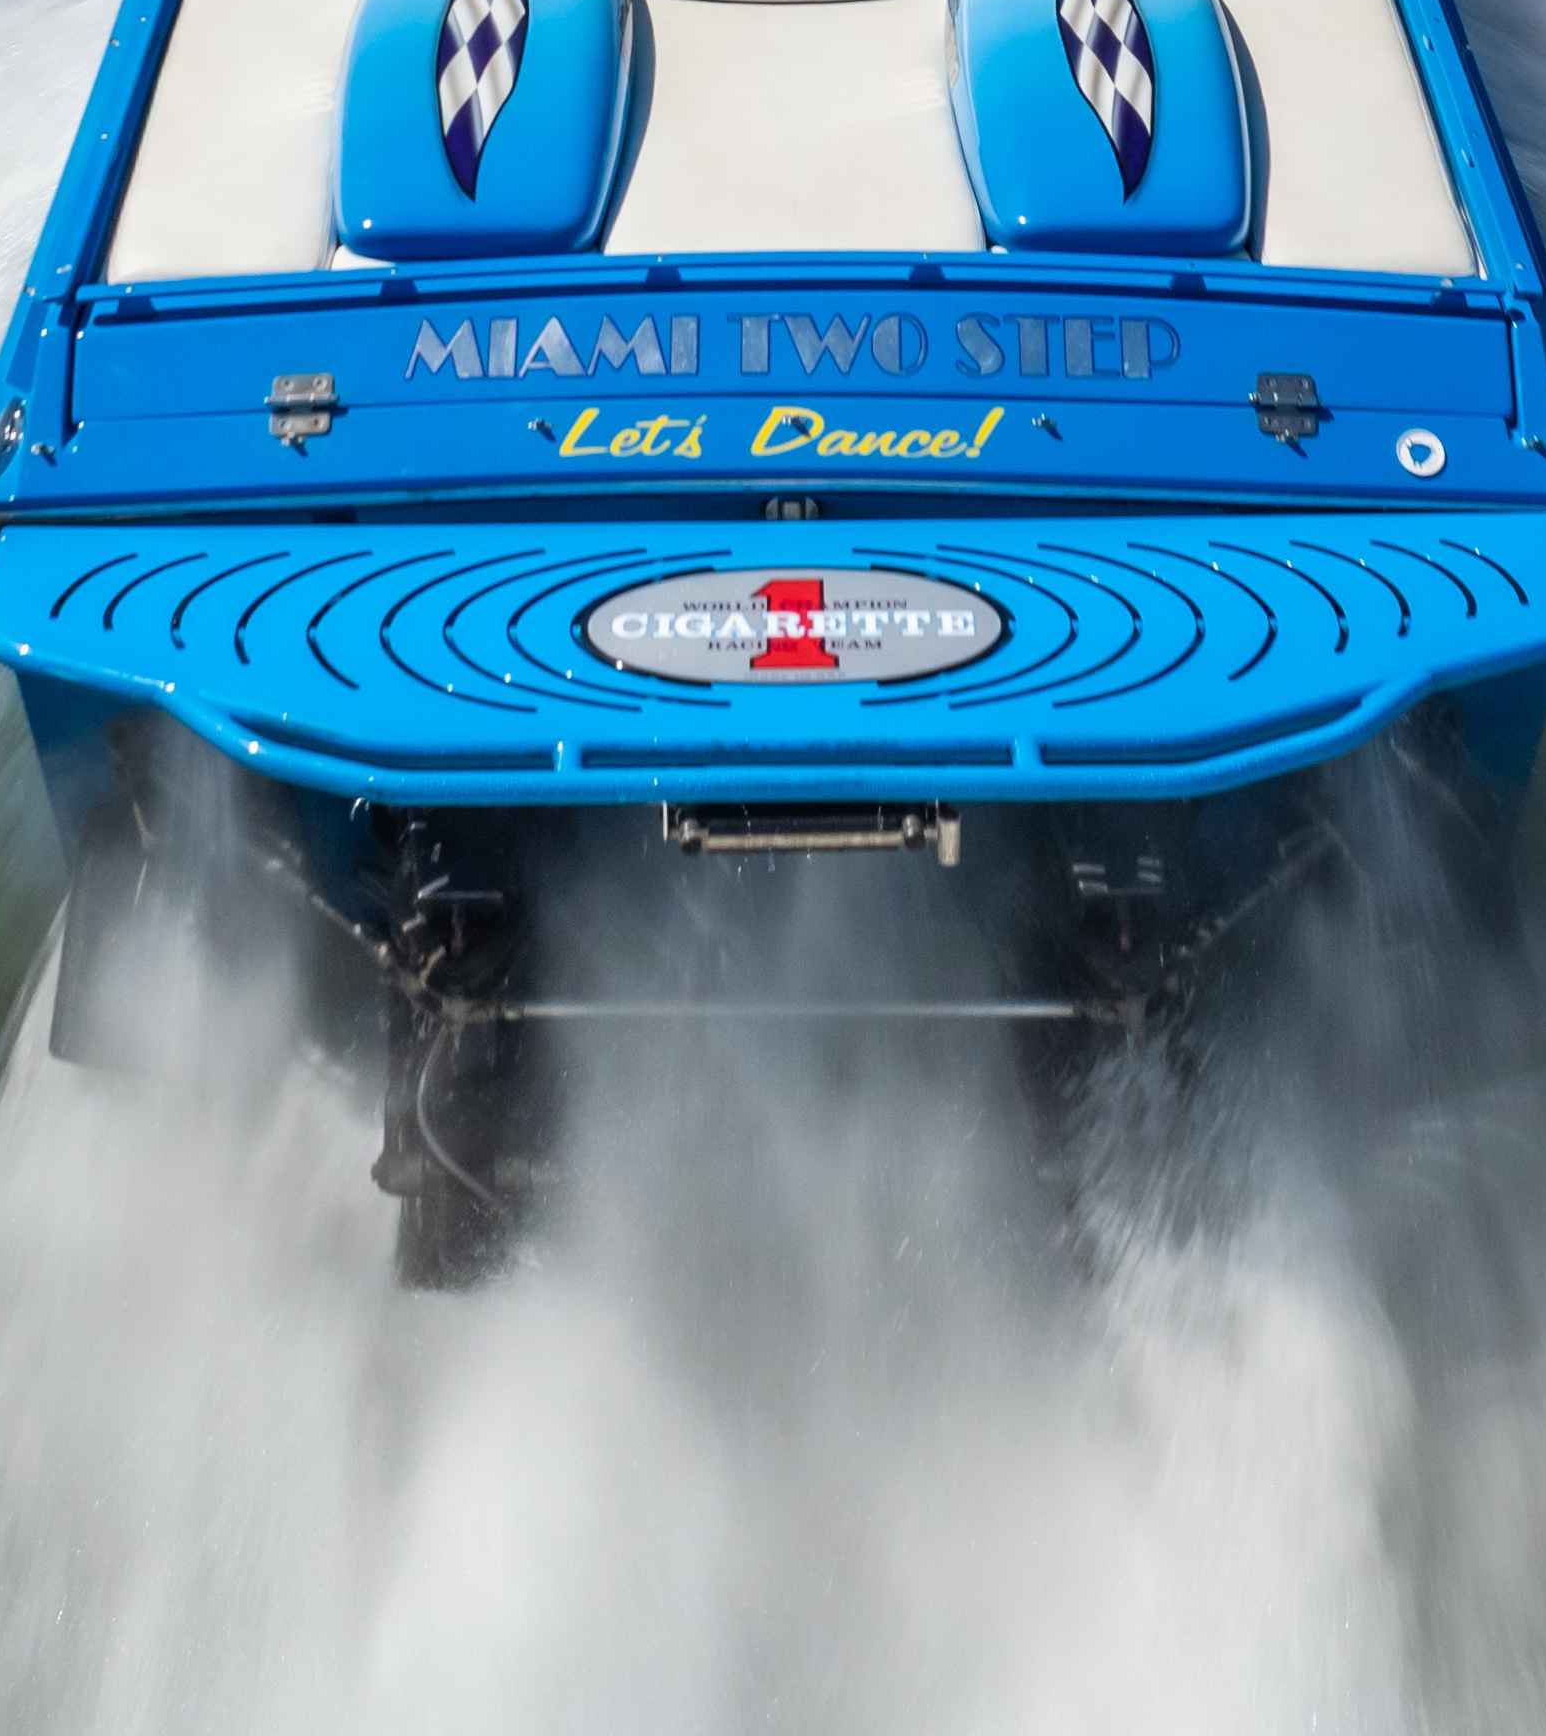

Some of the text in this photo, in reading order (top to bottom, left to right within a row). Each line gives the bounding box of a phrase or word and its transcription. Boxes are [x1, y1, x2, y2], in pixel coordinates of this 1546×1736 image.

[404, 311, 1182, 379] MIAMI TWO STEP
[558, 406, 1005, 459] Let's Dance!
[611, 610, 975, 639] CIGARETTE
[682, 601, 766, 612] WORLD
[750, 578, 840, 669] 1
